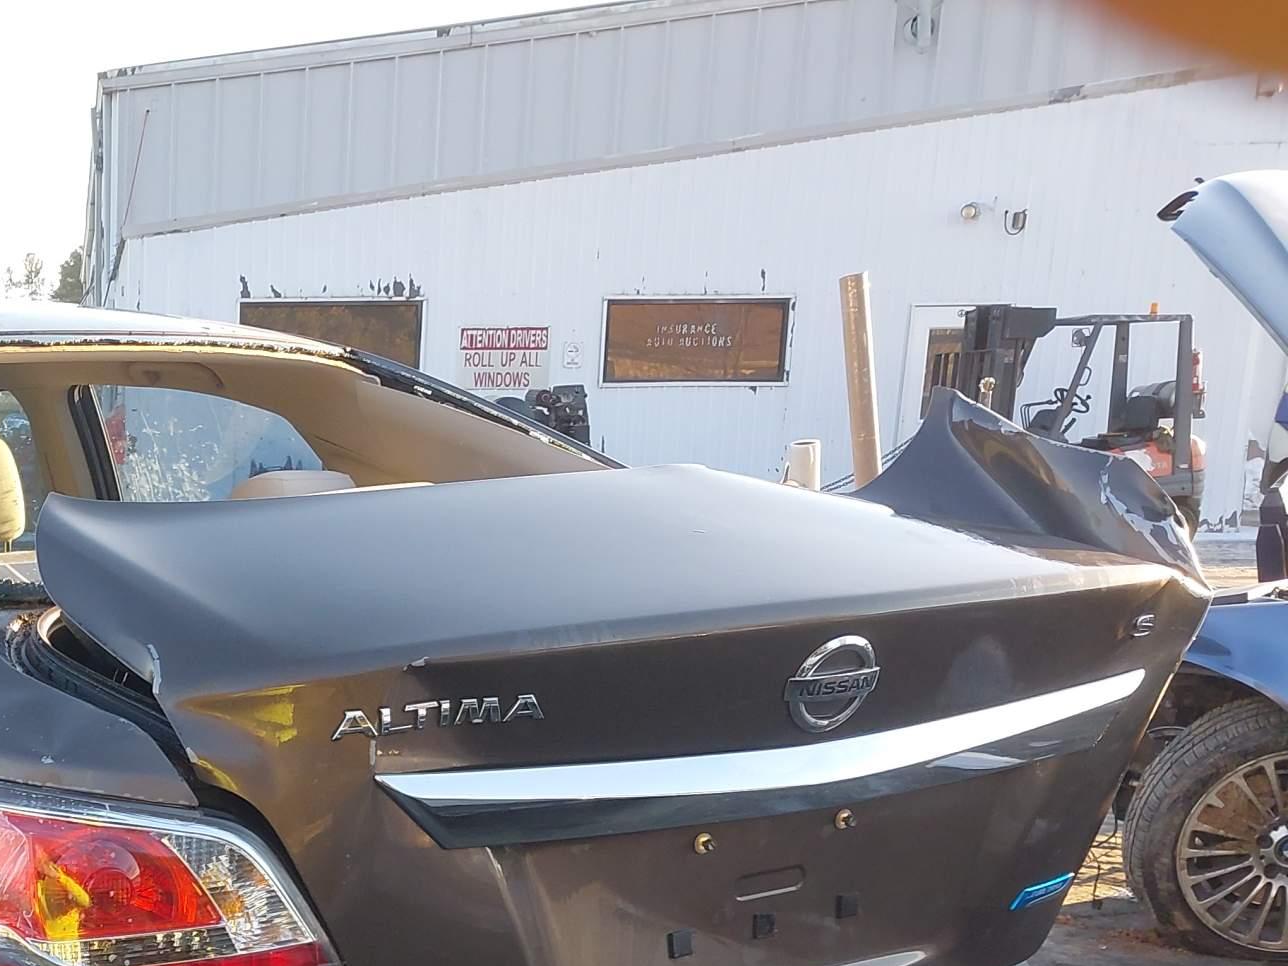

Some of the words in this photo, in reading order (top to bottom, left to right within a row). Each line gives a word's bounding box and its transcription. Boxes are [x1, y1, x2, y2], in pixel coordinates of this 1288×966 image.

[656, 323, 717, 335] INSURANCE
[462, 329, 508, 349] ATTENTION
[510, 328, 547, 348] DRIVERS
[464, 352, 494, 367] ROLL
[500, 352, 516, 367] UP
[519, 351, 541, 367] ALL
[473, 372, 530, 388] WINDOWS
[799, 676, 871, 697] NISSAN
[331, 694, 545, 741] ALTIMA
